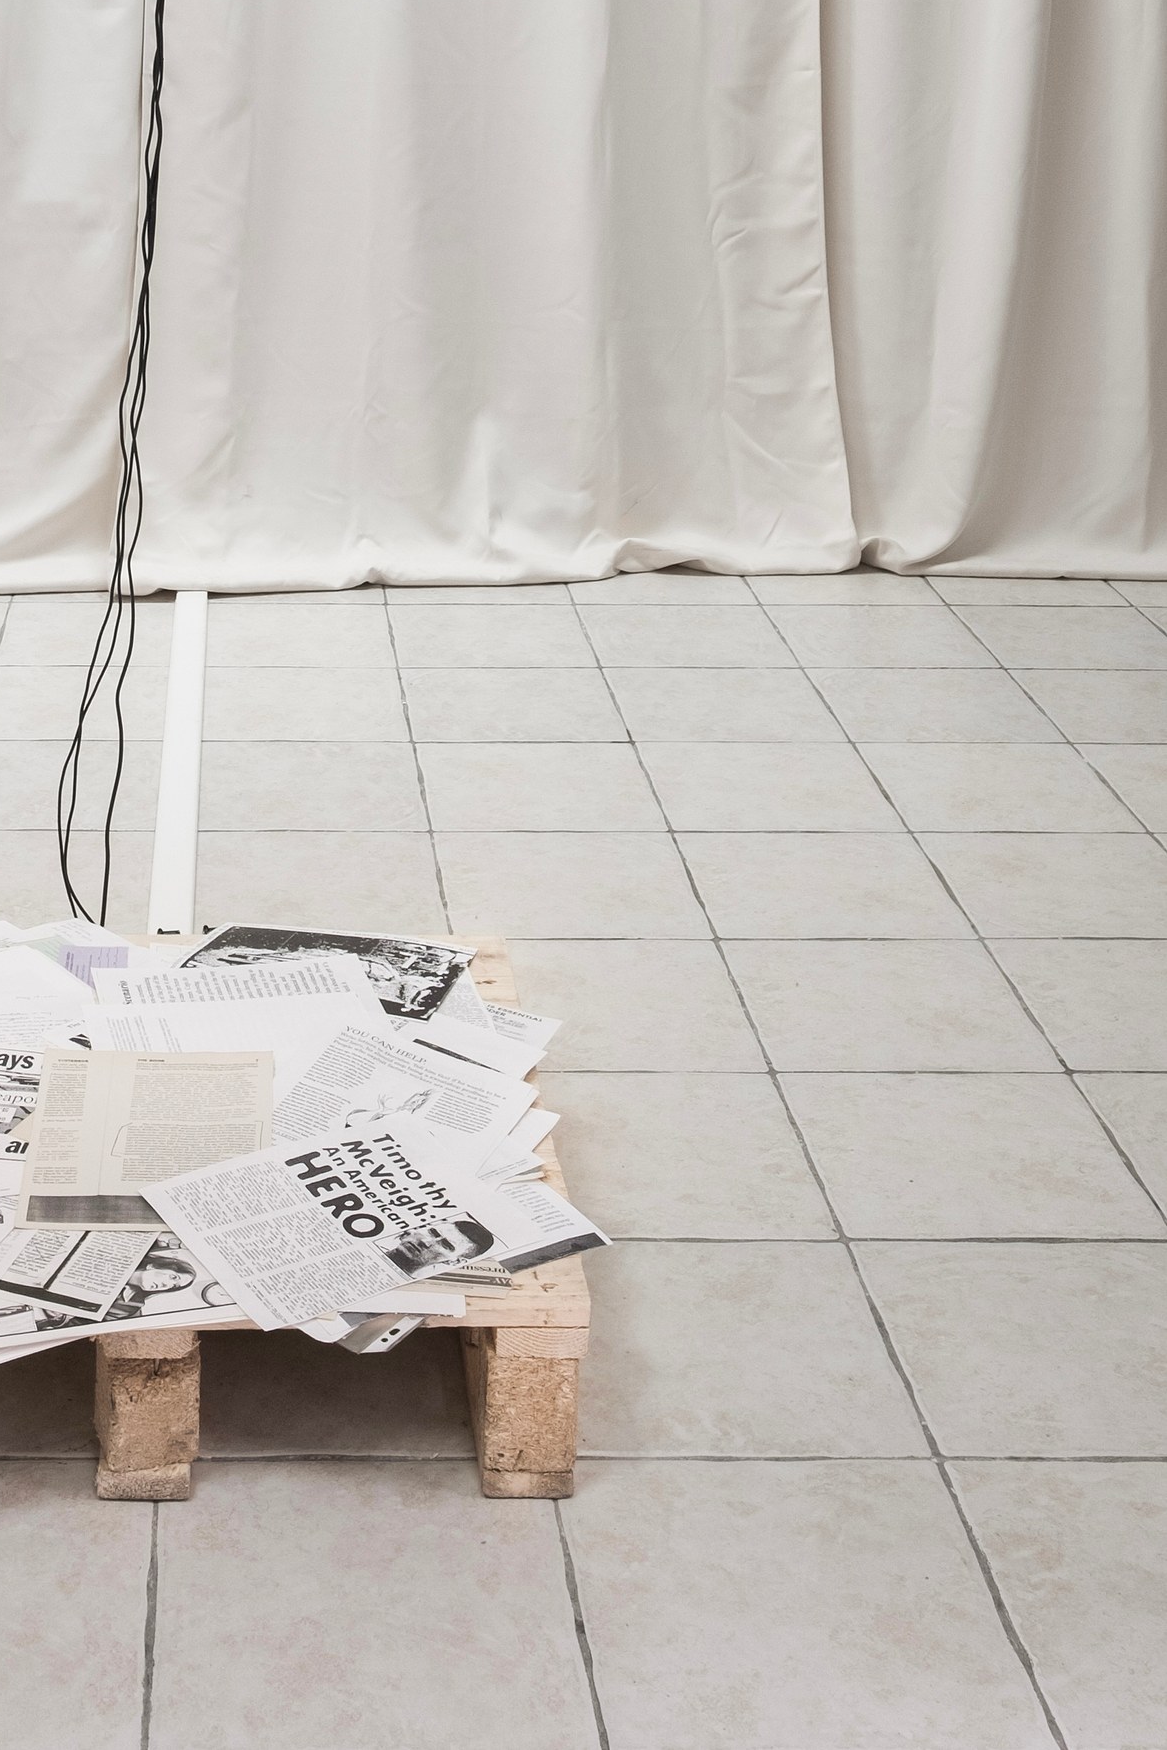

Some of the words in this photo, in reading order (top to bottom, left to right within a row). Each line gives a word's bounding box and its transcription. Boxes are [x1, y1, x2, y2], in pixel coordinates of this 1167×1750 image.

[346, 1025, 370, 1038] YOU
[371, 1035, 395, 1051] CAN
[284, 1150, 385, 1239] HERO
[322, 1146, 346, 1167] An
[342, 1168, 410, 1230] American
